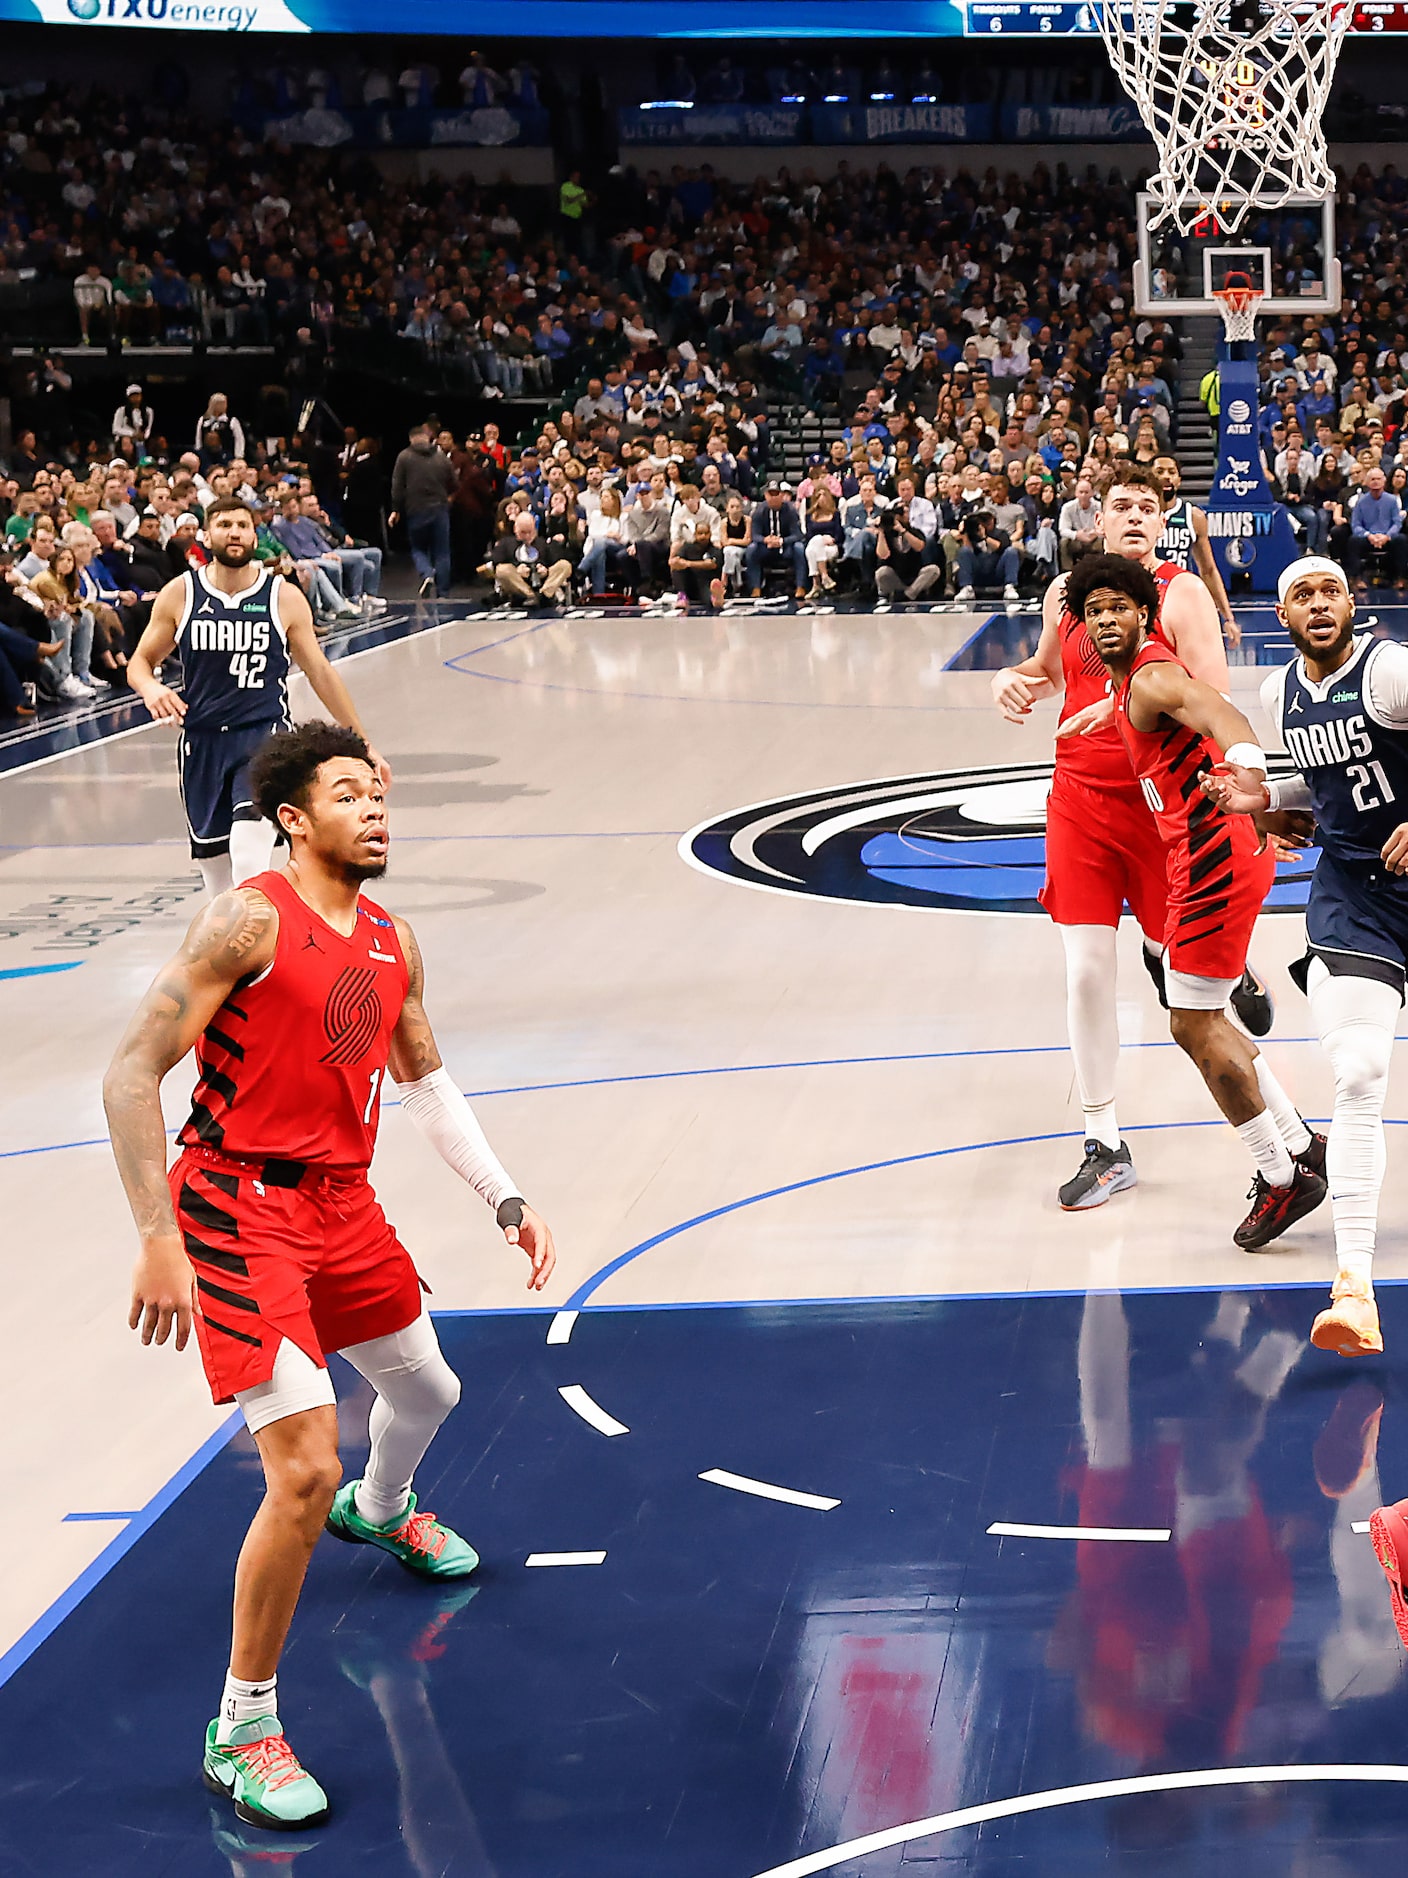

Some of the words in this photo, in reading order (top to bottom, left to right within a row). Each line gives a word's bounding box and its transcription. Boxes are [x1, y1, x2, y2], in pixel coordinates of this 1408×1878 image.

[989, 16, 1002, 32] 6
[1040, 16, 1052, 32] 5
[1371, 16, 1384, 31] 3
[866, 107, 966, 138] BREAKERS
[1219, 473, 1258, 496] Kroger
[1157, 527, 1190, 549] AVS
[191, 620, 270, 652] MAVS
[229, 653, 267, 688] 42
[1332, 691, 1358, 704] chime
[1285, 715, 1373, 769] MAVS
[1346, 760, 1396, 812] 21
[33, 869, 206, 951] merican
[363, 1068, 381, 1124] 1
